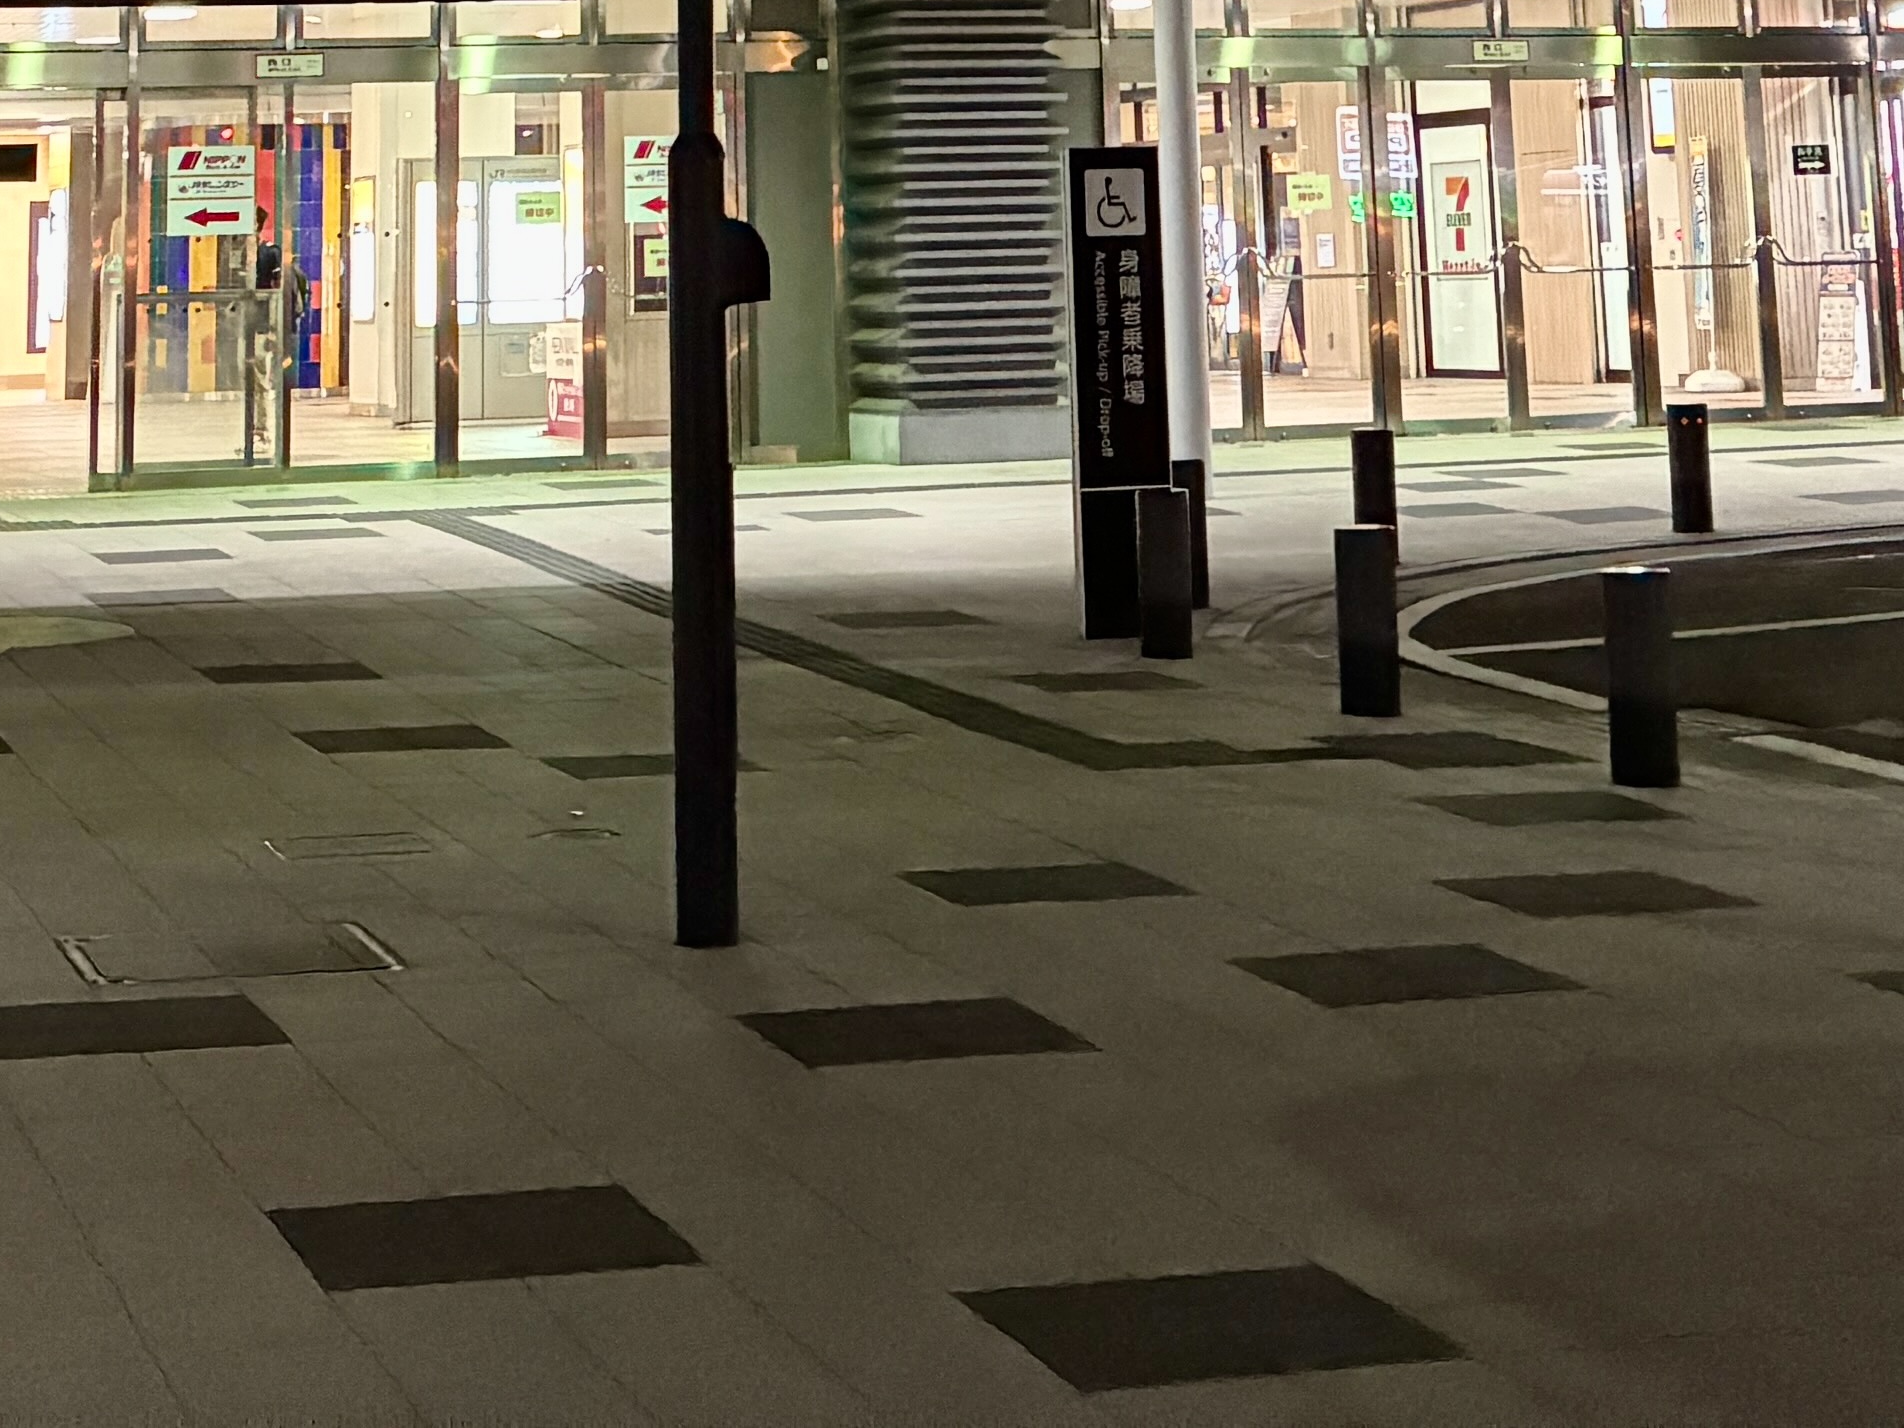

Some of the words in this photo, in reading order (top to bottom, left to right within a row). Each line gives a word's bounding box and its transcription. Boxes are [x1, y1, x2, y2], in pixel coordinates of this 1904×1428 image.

[1093, 250, 1110, 326] Accessible
[1118, 249, 1146, 406] 身障者乗降場
[1097, 397, 1115, 459] Drop-off
